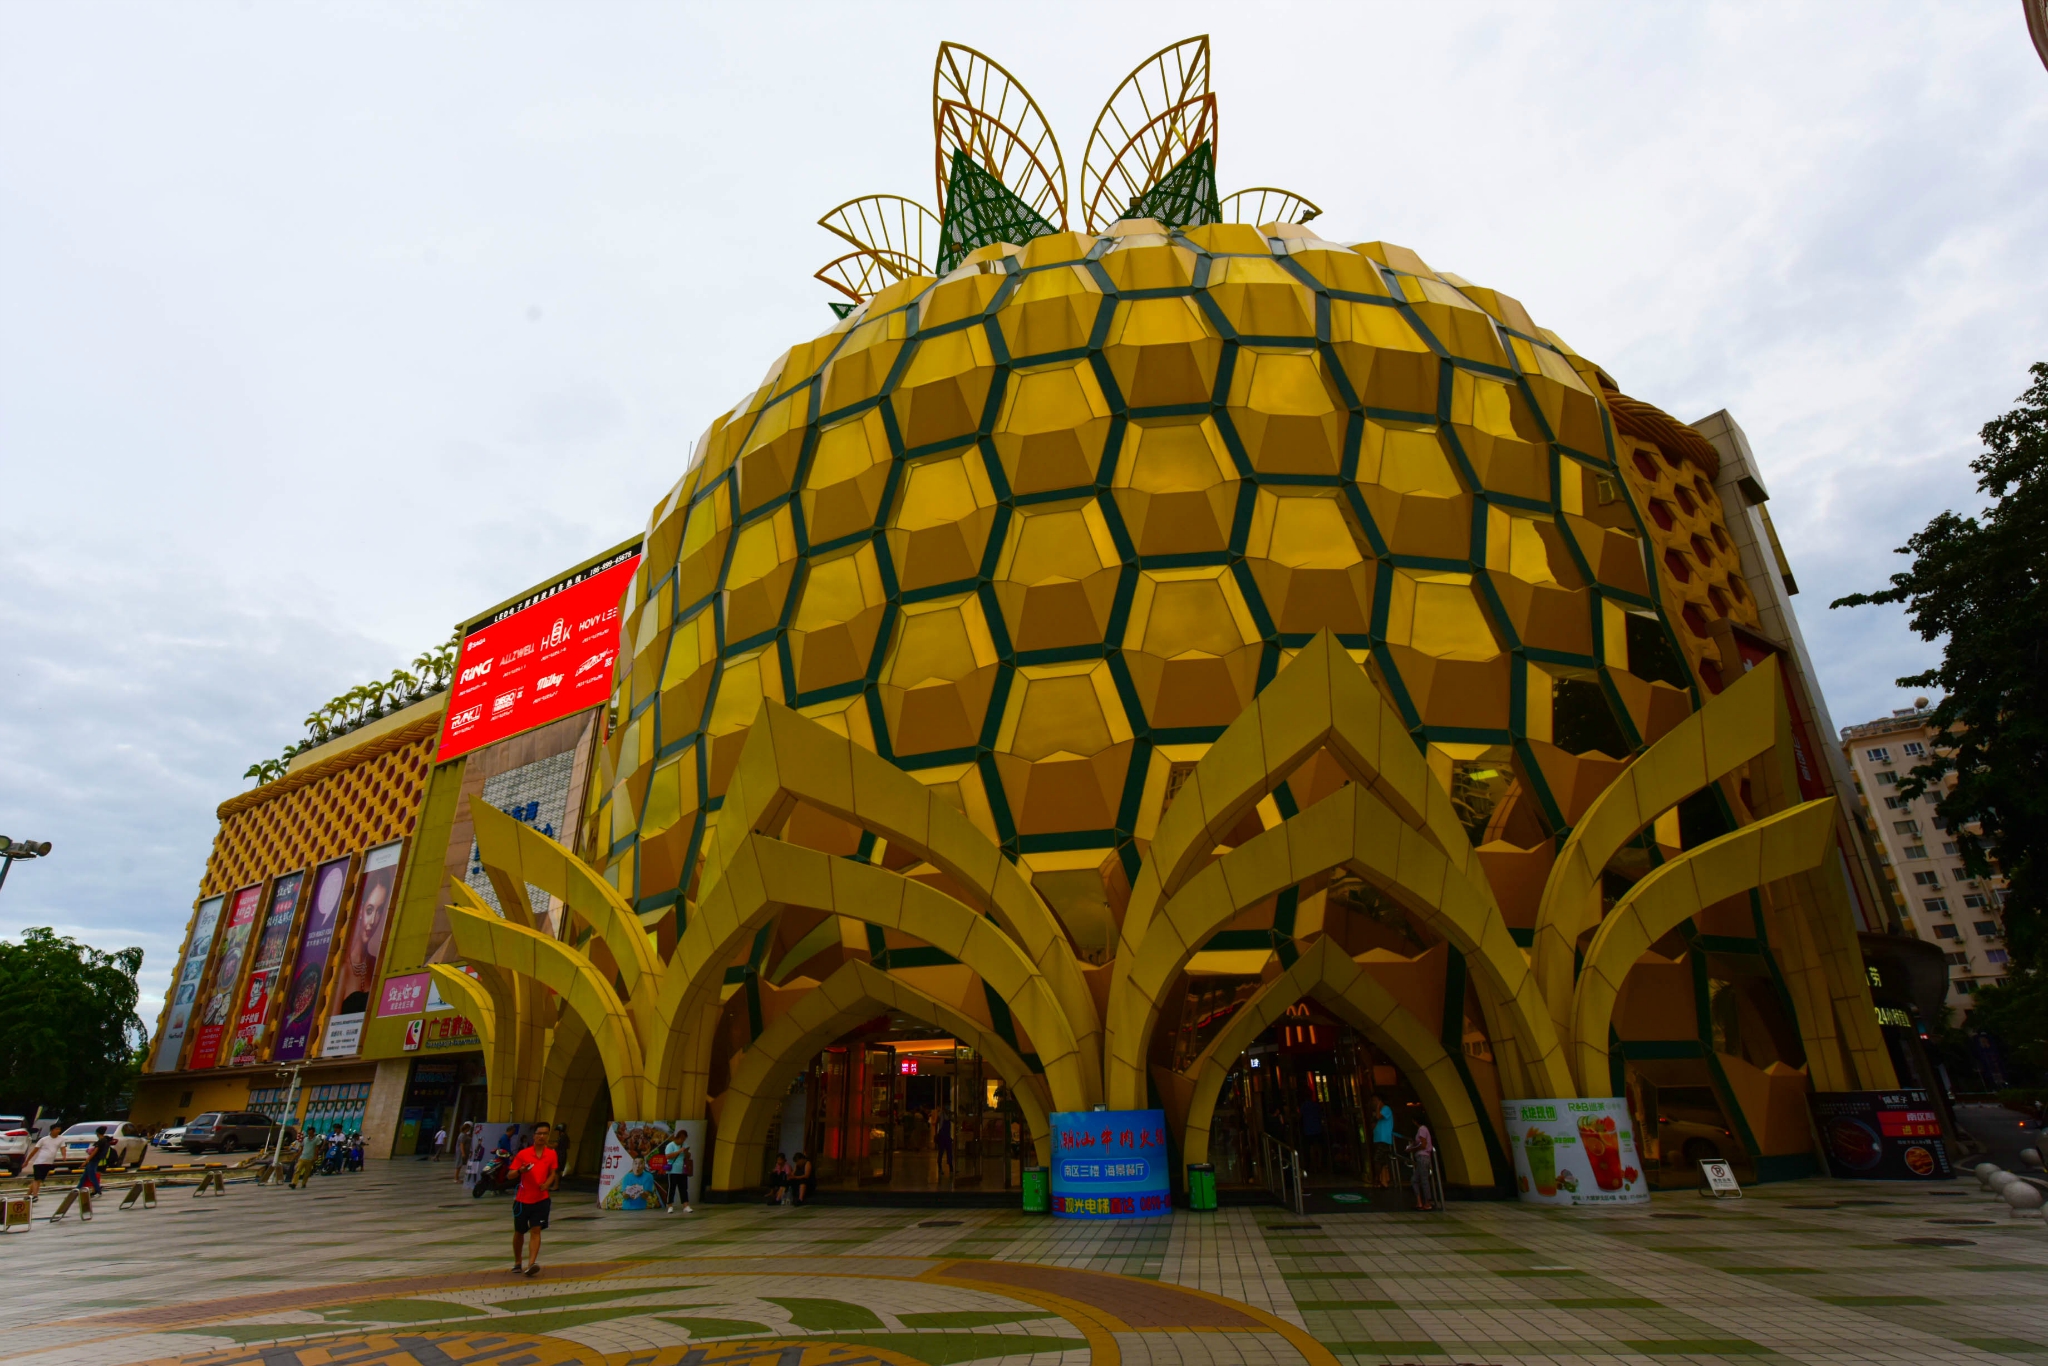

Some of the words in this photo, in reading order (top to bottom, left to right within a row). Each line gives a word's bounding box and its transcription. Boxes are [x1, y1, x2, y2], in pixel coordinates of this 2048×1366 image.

[579, 614, 600, 631] HOVY
[460, 657, 494, 684] RING
[1064, 1165, 1100, 1178] 南区三楼
[1105, 1163, 1145, 1177] 海景餐厅
